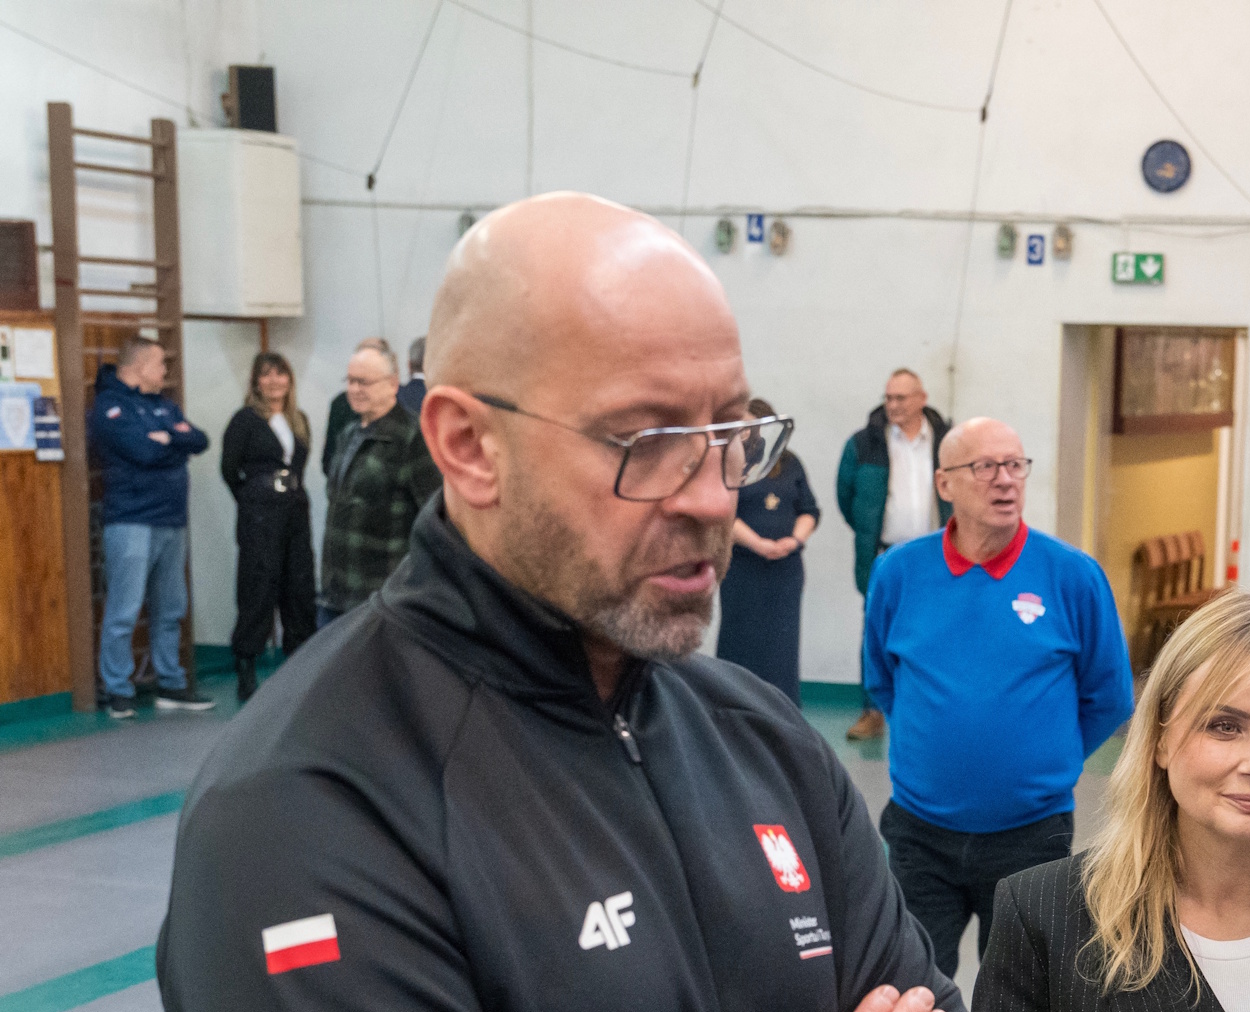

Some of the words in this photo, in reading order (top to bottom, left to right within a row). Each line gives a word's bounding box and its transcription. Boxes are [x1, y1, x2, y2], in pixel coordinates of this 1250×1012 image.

[749, 215, 762, 237] 4
[1029, 237, 1043, 260] 3
[578, 890, 636, 951] 4F
